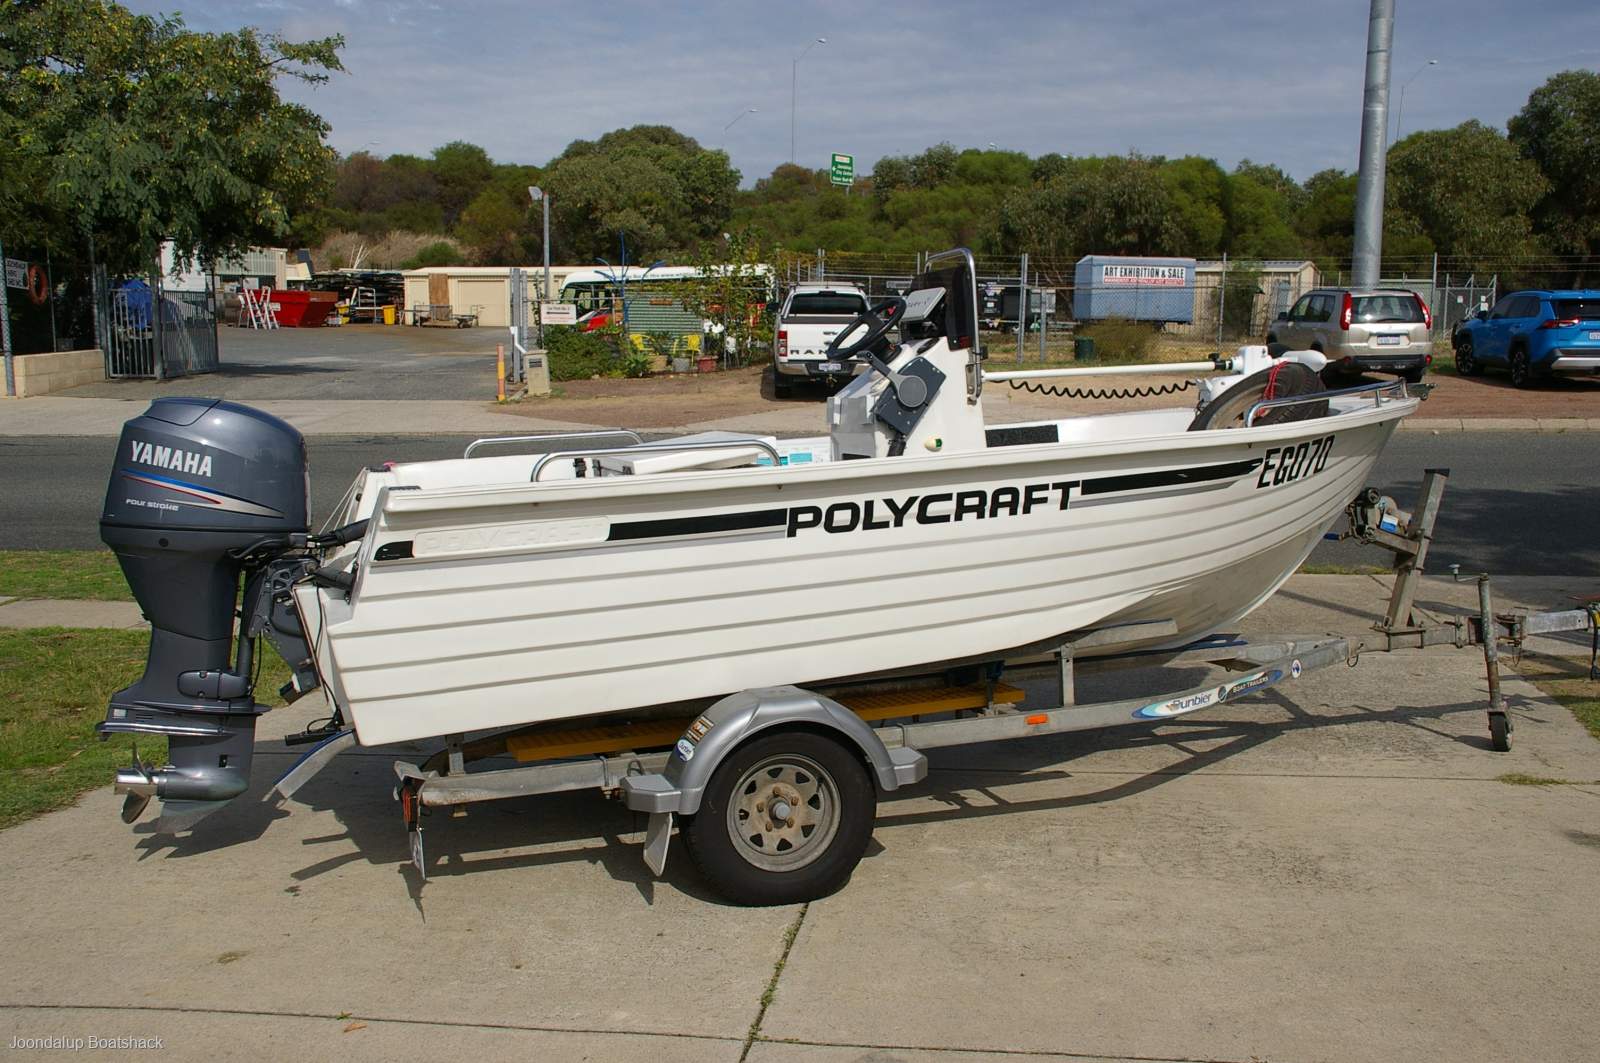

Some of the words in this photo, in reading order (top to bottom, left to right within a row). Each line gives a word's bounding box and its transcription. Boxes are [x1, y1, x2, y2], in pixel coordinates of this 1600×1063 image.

[1104, 266, 1118, 277] ART
[1119, 267, 1160, 278] EXHIBITION
[1161, 270, 1166, 278] &
[1167, 268, 1185, 279] SALE
[130, 440, 213, 478] YAMAHA
[787, 480, 1081, 538] POLYCRAFT
